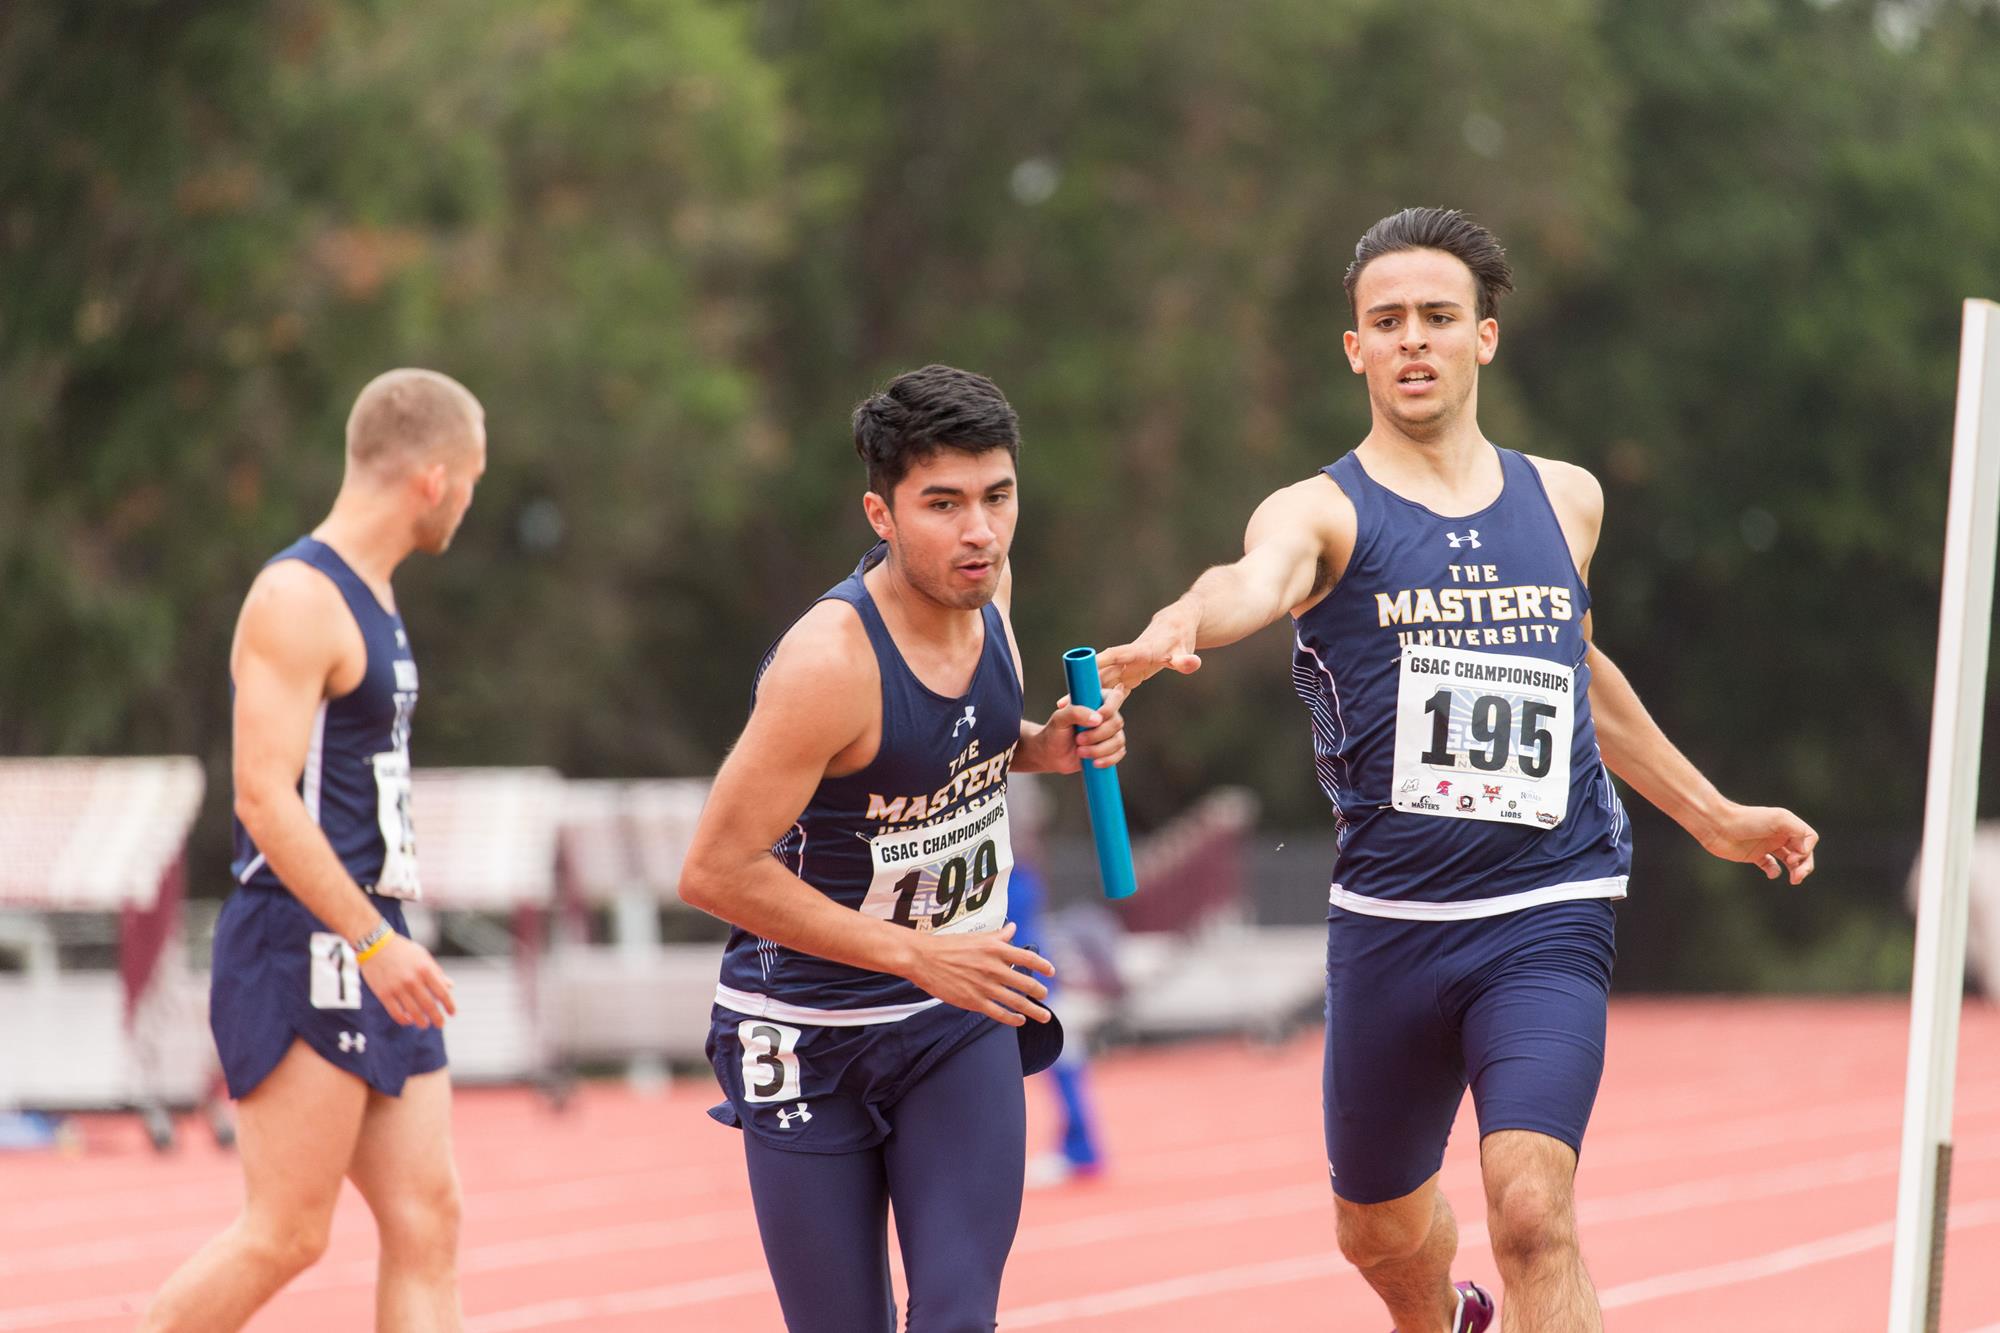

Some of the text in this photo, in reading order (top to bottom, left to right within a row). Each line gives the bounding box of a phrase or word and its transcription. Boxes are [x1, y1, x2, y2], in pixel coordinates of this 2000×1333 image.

[1449, 564, 1499, 582] THE
[1374, 585, 1573, 628] MASTER'S
[1397, 624, 1560, 648] UNIVERSITY
[1410, 656, 1569, 693] GSAC CHAMPIONSHIPS
[949, 739, 980, 777] THE
[1420, 690, 1557, 778] 195
[881, 802, 1004, 863] GSAC CHAMPIONSHIPS
[883, 839, 999, 930] 199
[328, 942, 346, 1001] 1
[751, 1025, 785, 1098] 3
